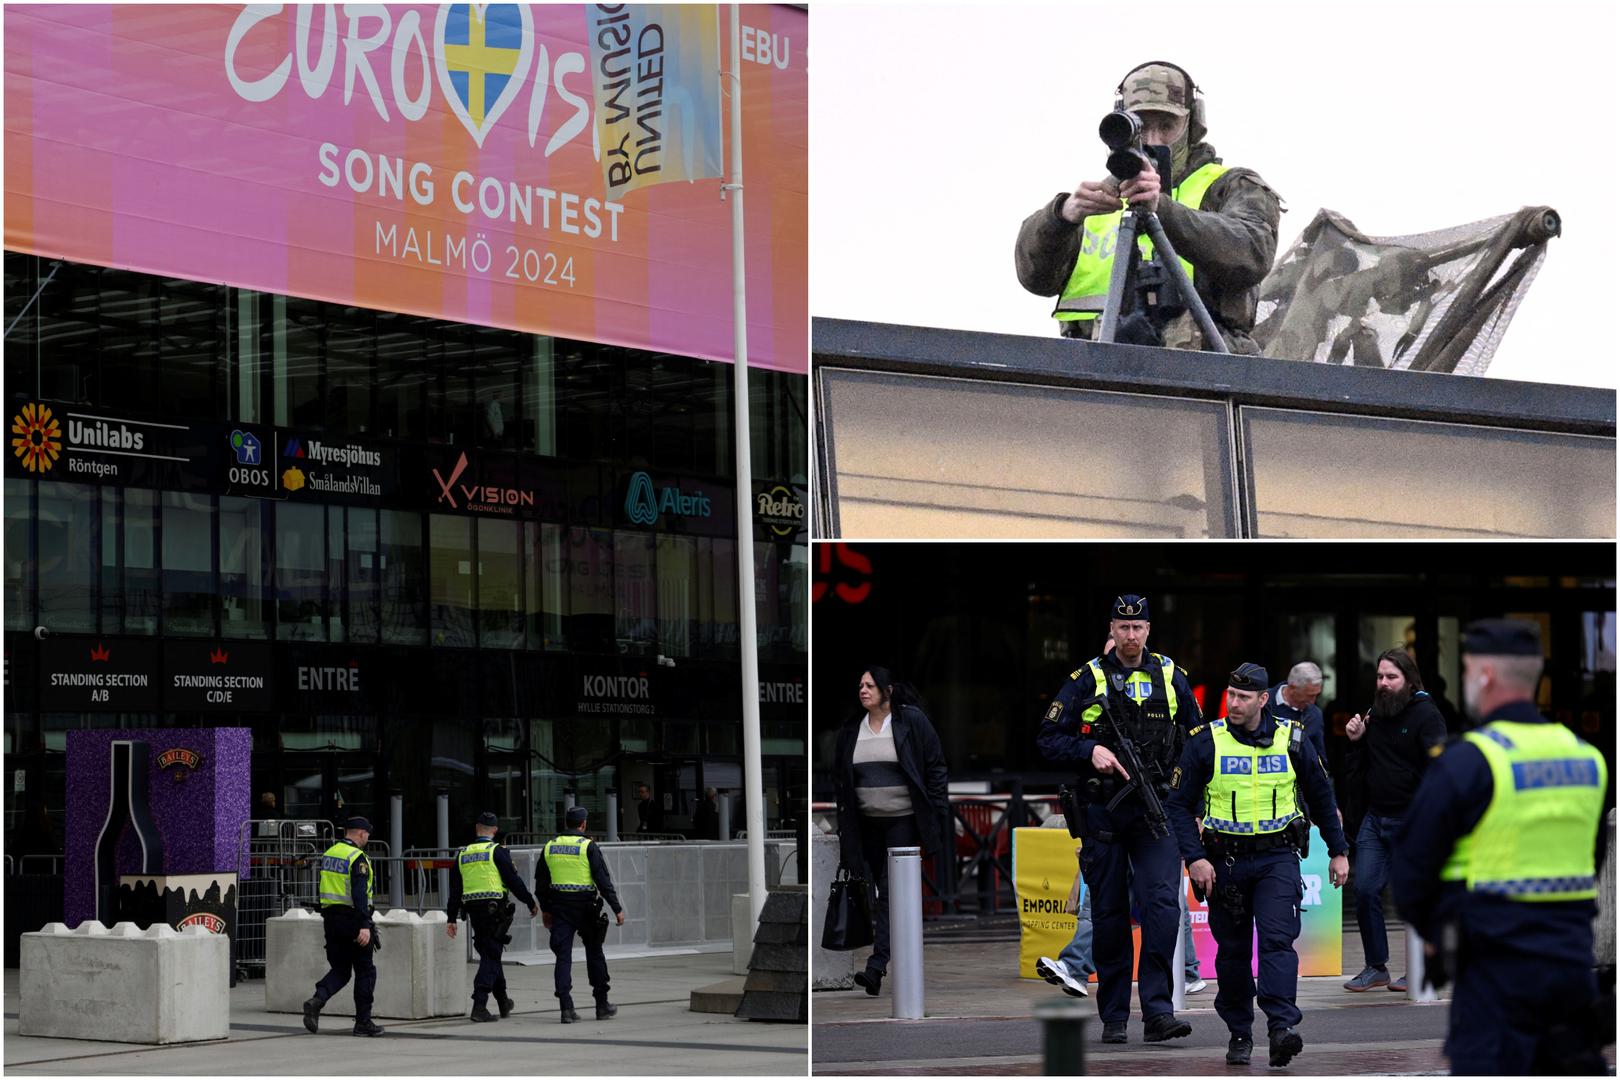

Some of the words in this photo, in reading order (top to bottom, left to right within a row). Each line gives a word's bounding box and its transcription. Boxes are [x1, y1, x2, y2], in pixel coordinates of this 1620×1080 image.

[741, 25, 790, 70] EBU
[318, 143, 434, 205] SONG
[451, 172, 625, 242] CONTEST
[375, 221, 492, 273] MALMÖ
[505, 246, 577, 288] 2024
[68, 420, 144, 450] Unilabs
[307, 440, 381, 468] Myresjöhus
[69, 457, 118, 477] Röntgen
[229, 467, 269, 487] OBOS
[309, 471, 381, 496] SmålandsVillan
[659, 487, 711, 517] Aleris
[757, 493, 805, 518] Retro
[51, 673, 104, 687] STANDING
[106, 674, 148, 688] SECTION
[174, 675, 221, 688] STANDING
[224, 676, 263, 689] SECTION
[584, 675, 649, 698] KONTOR
[92, 688, 109, 702] A/B
[206, 690, 232, 703] C/D/E
[160, 751, 196, 765] BAILEYS
[1226, 755, 1282, 773] POLIS
[463, 852, 486, 863] POLIS
[551, 845, 578, 855] POLIS
[322, 857, 344, 873] OLIS
[1051, 921, 1075, 930] CENTER
